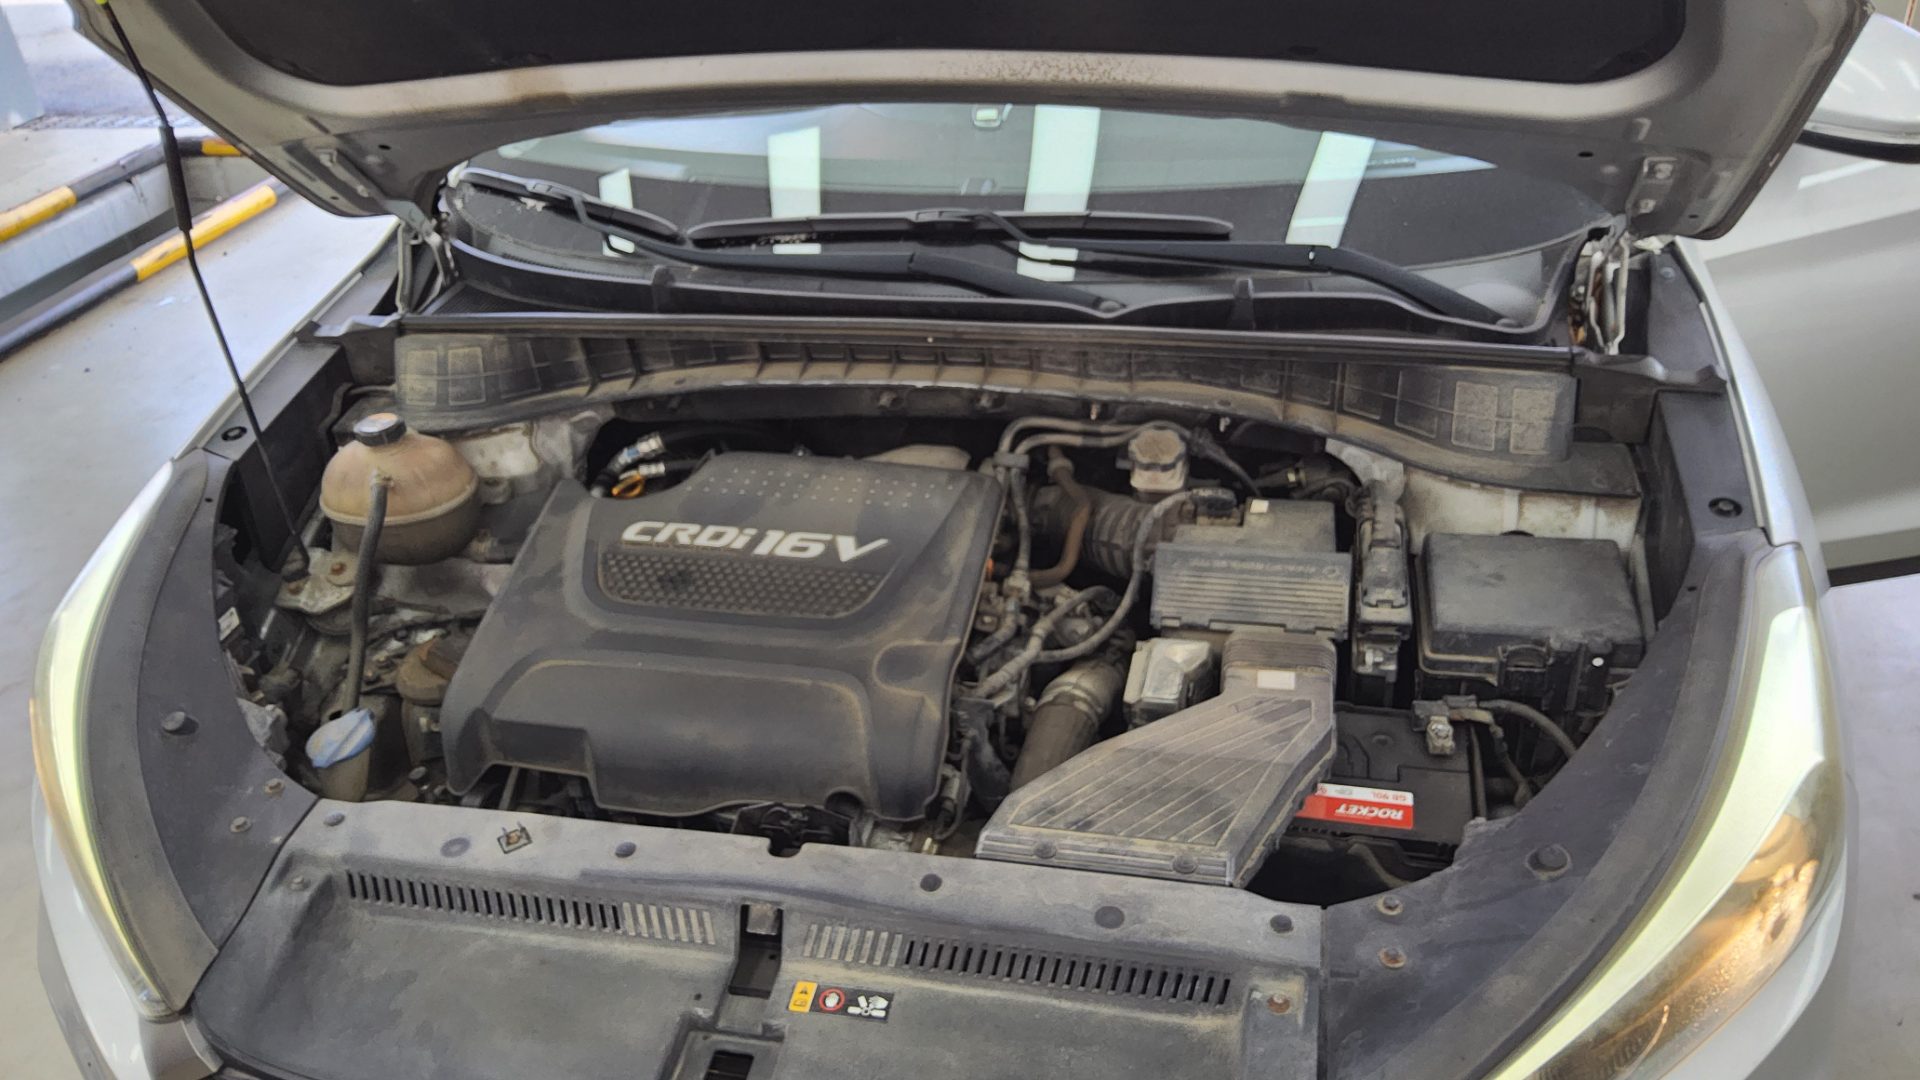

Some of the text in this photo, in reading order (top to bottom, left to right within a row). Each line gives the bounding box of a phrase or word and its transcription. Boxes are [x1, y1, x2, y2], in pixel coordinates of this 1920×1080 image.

[621, 520, 889, 562] CRDi 16V
[1335, 803, 1405, 820] ROCKET
